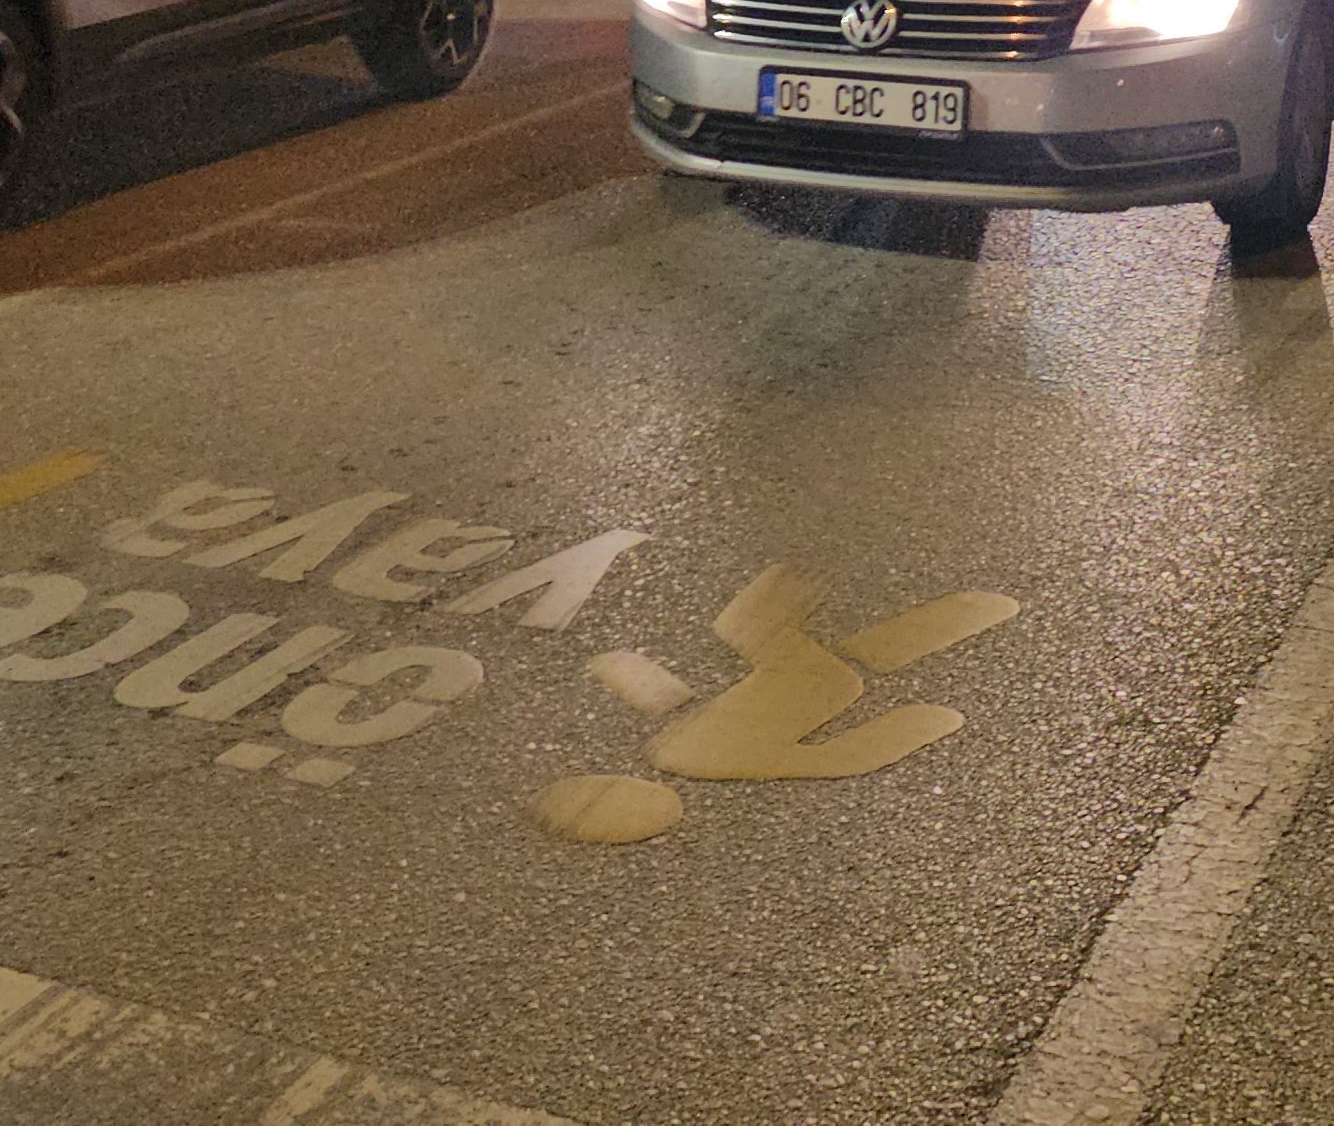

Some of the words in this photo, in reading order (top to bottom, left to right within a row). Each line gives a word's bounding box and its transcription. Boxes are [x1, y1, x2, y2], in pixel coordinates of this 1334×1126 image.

[779, 80, 811, 112] 06
[835, 84, 884, 118] CBC
[911, 90, 958, 124] 819
[100, 480, 653, 632] yaya
